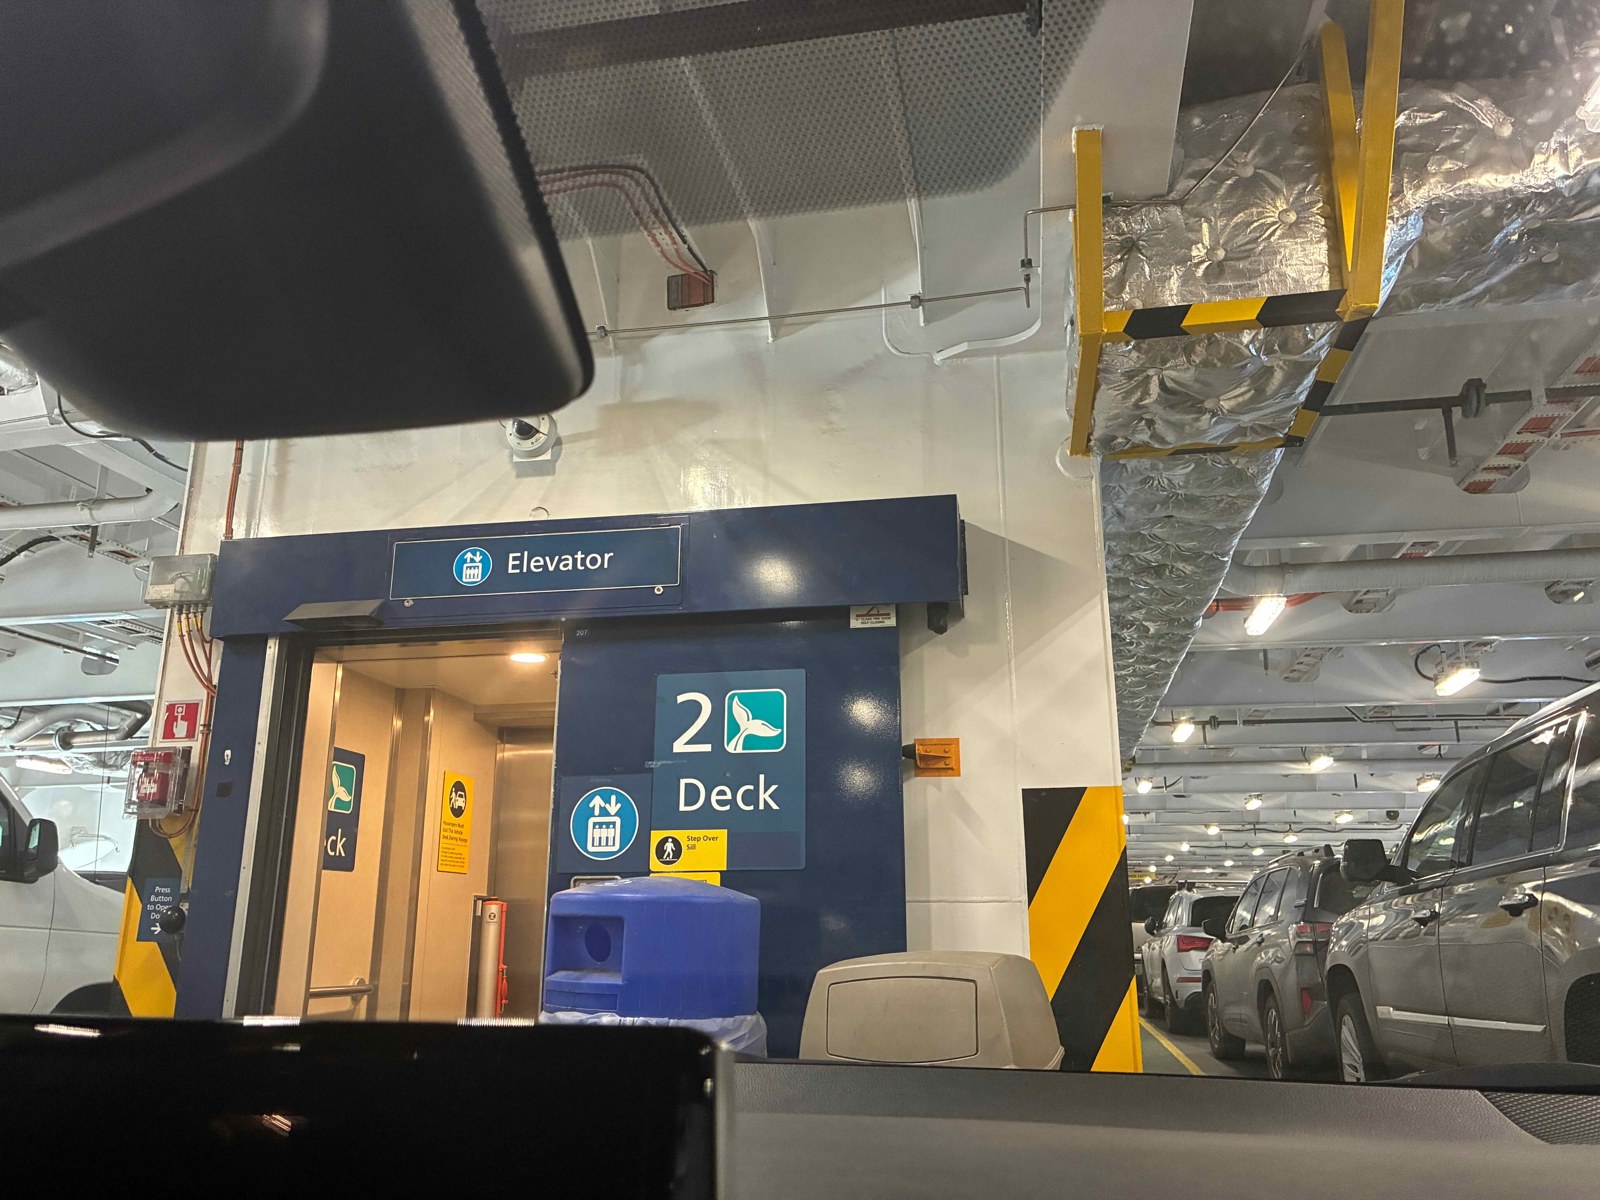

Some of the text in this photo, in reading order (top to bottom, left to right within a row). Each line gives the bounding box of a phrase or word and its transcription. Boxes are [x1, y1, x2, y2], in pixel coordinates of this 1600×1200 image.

[507, 550, 614, 574] Elevator
[672, 691, 712, 753] 2
[678, 773, 780, 812] Deck
[686, 834, 719, 843] Step Over
[686, 843, 697, 851] Sill
[150, 894, 173, 902] Button
